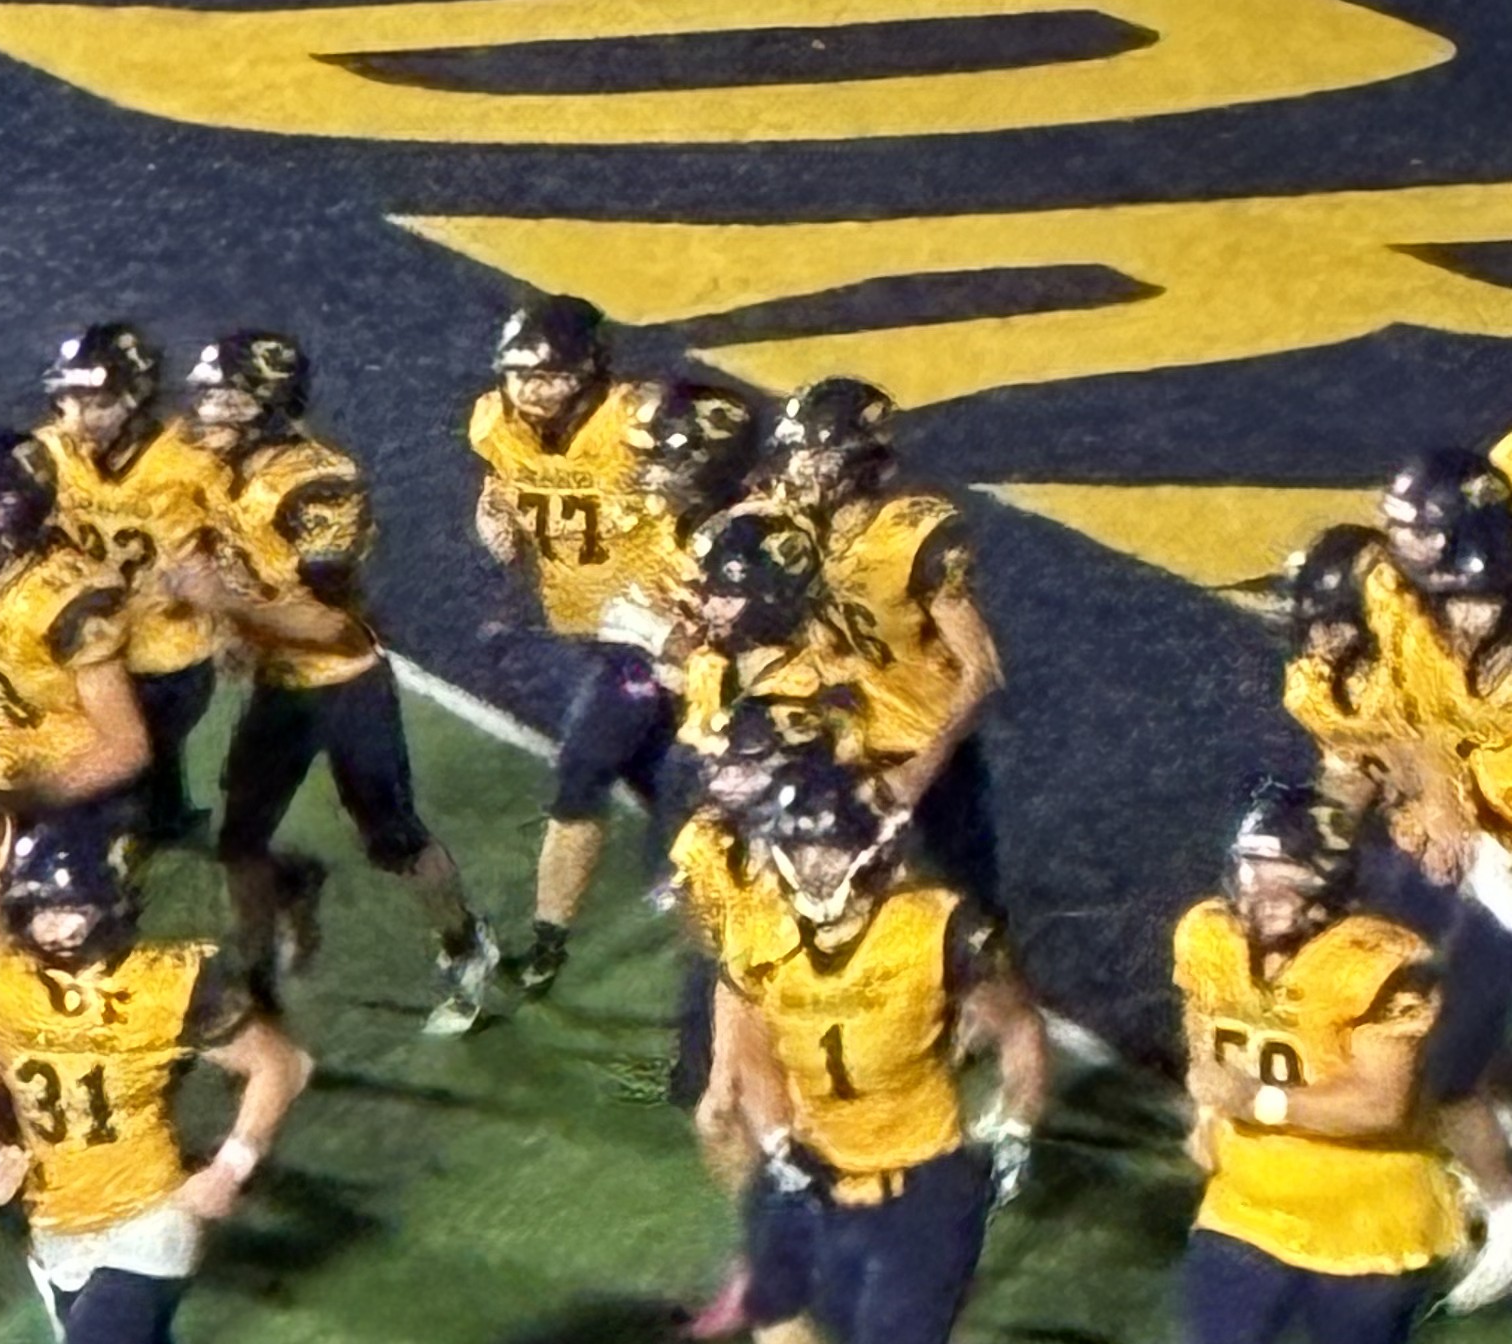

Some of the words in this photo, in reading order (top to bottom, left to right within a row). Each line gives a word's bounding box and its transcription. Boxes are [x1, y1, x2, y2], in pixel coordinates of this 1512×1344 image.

[517, 491, 611, 566] 77
[817, 1022, 858, 1100] 1
[14, 1057, 119, 1145] 31
